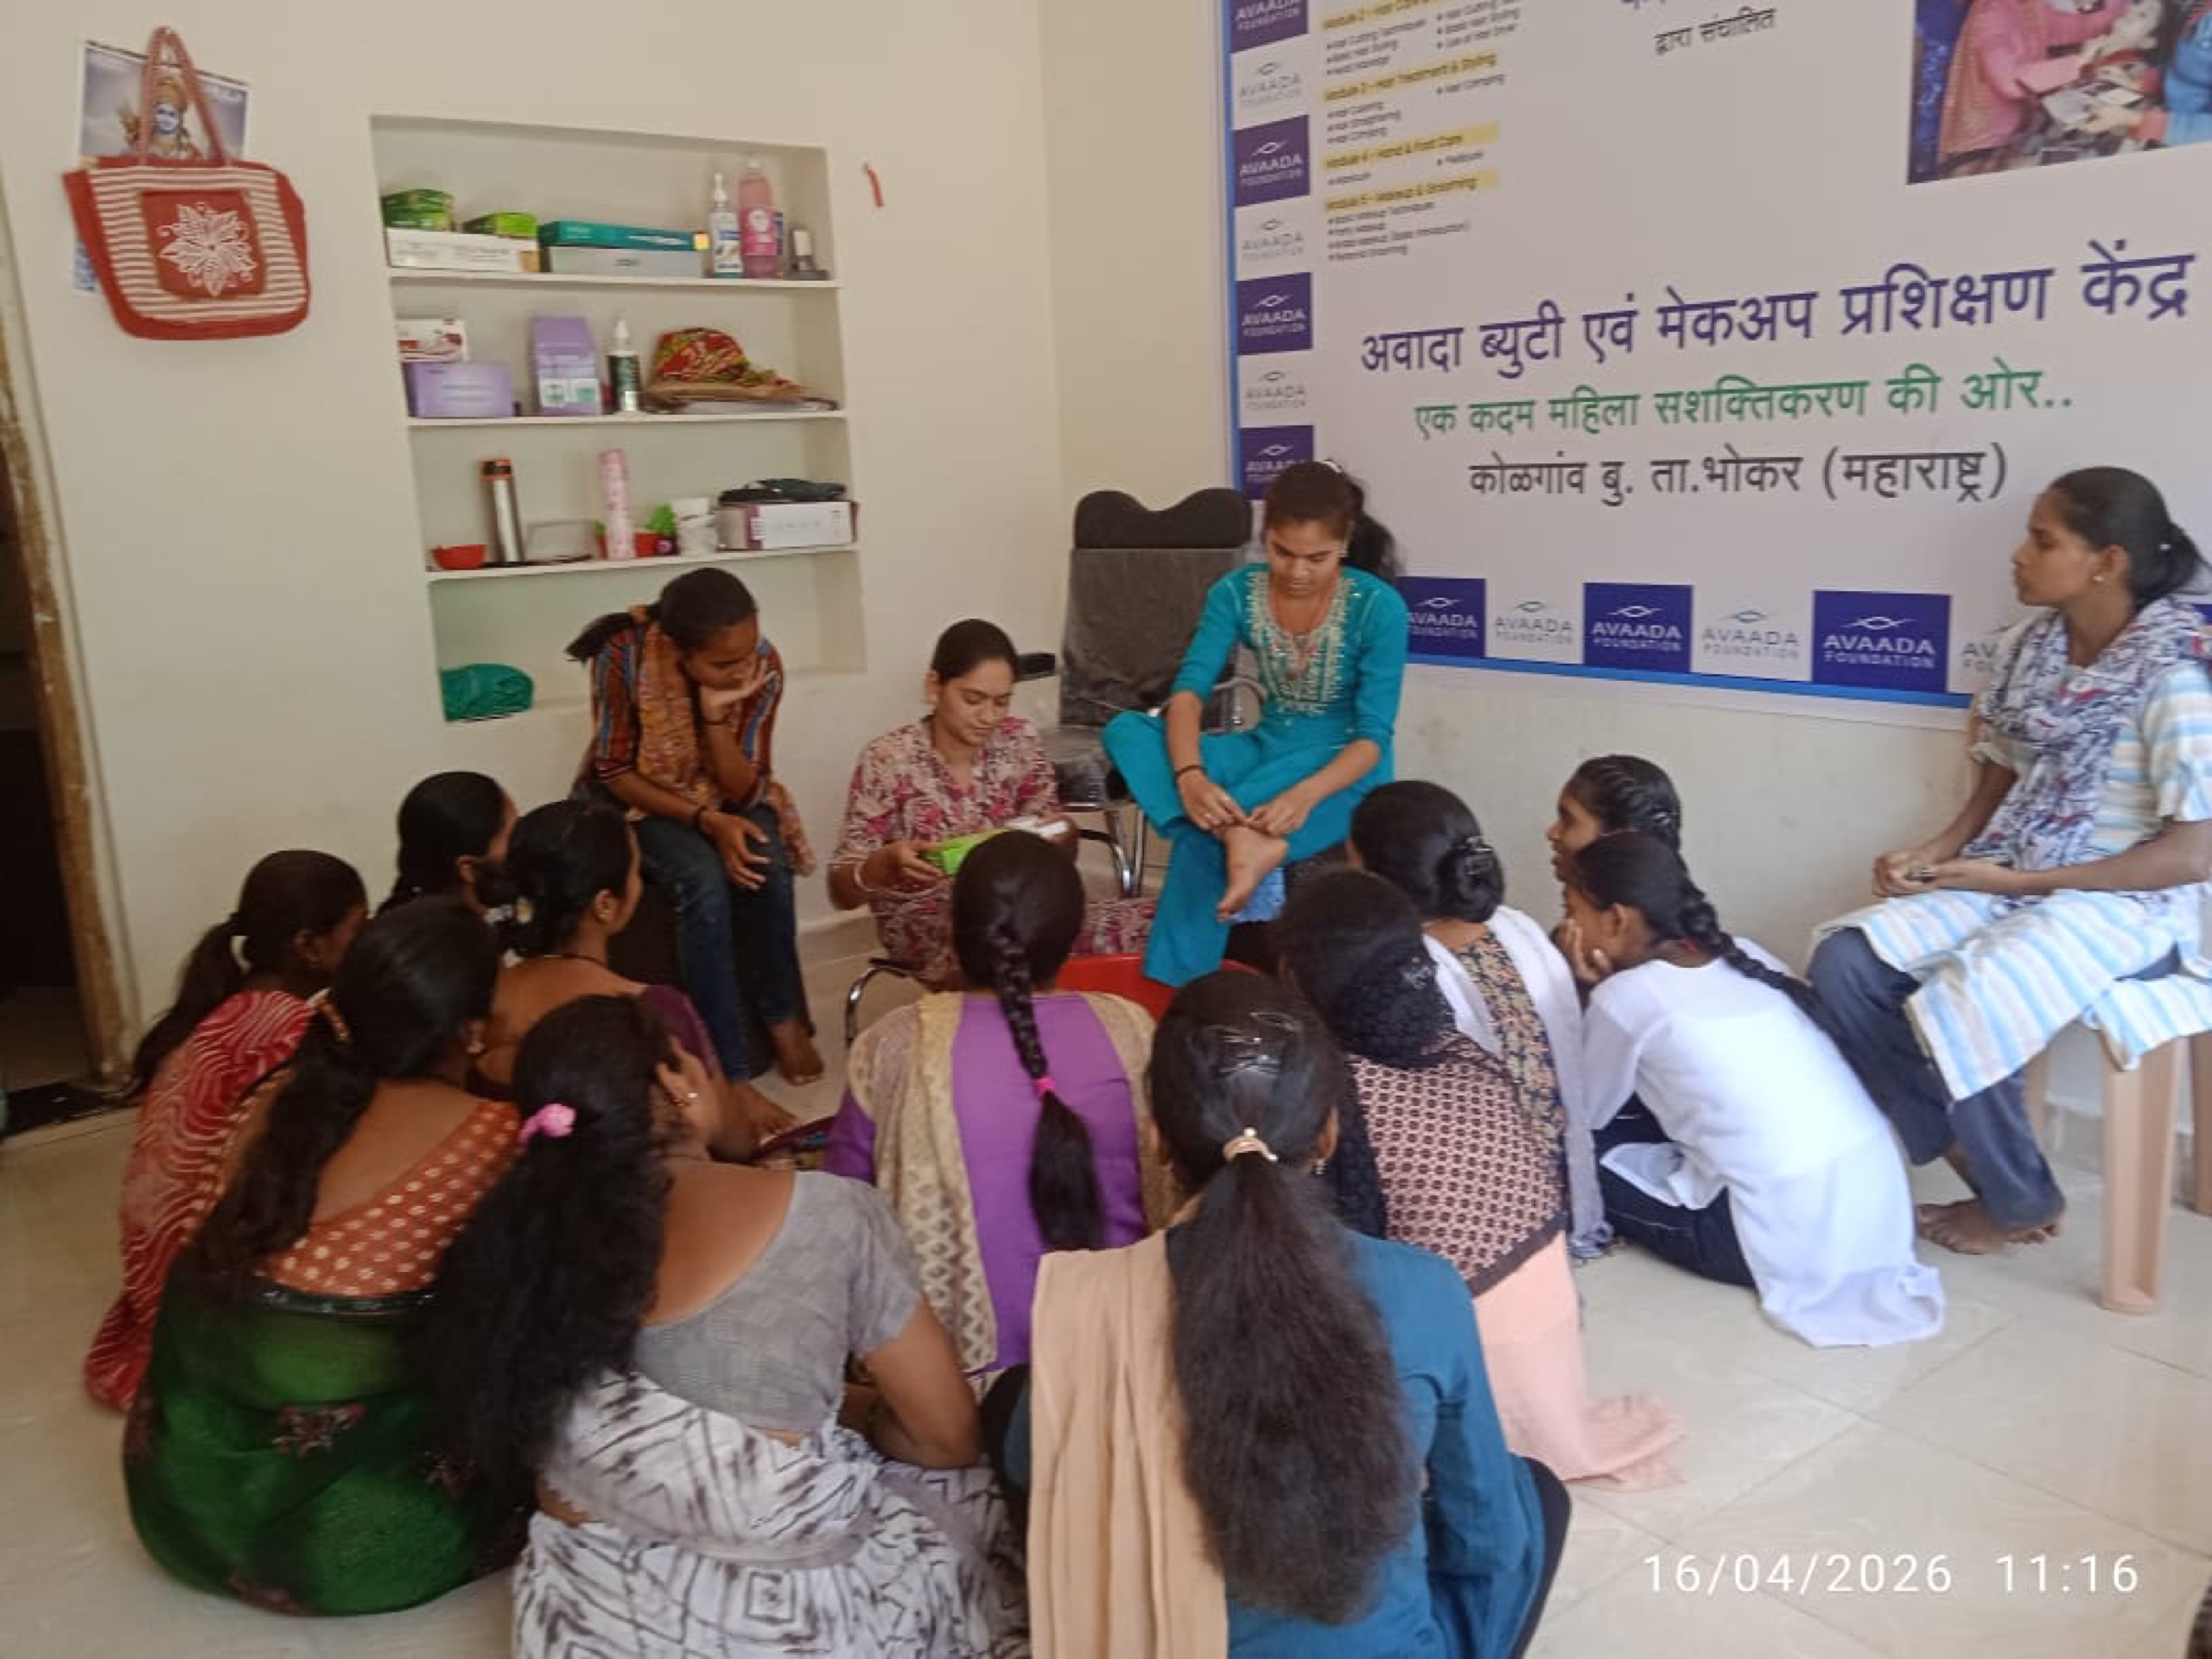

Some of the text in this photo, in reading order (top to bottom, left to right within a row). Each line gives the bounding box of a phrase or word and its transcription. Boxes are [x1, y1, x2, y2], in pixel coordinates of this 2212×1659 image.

[1653, 6, 1777, 55] द्वारा संचालित
[1240, 153, 1302, 176] AVAADA
[1242, 232, 1303, 251] AVAADA
[1242, 307, 1306, 327] AVAADA
[1361, 239, 2196, 378] अवादा ब्युटी एवं मेकअप प्रशिक्षण केंद्र
[1244, 384, 1306, 399] AVAADA
[1414, 357, 2073, 441] एक कदम महिला सशक्तिकरण की ओर..
[1469, 450, 1588, 494] कोळगांव
[1600, 461, 1634, 507] बु.
[1822, 442, 2007, 503] (महाराष्ट्र)
[1495, 615, 1573, 634] AVAADA
[1592, 621, 1683, 641] AVAADA
[1496, 630, 1573, 645] FOUNDATION
[1592, 635, 1683, 652] FOUNDATION
[1702, 627, 1800, 647] AVAADA
[1824, 633, 1936, 657] AVAADA
[1703, 642, 1800, 659] FOUNDATION
[1825, 651, 1935, 671] FOUNDATION
